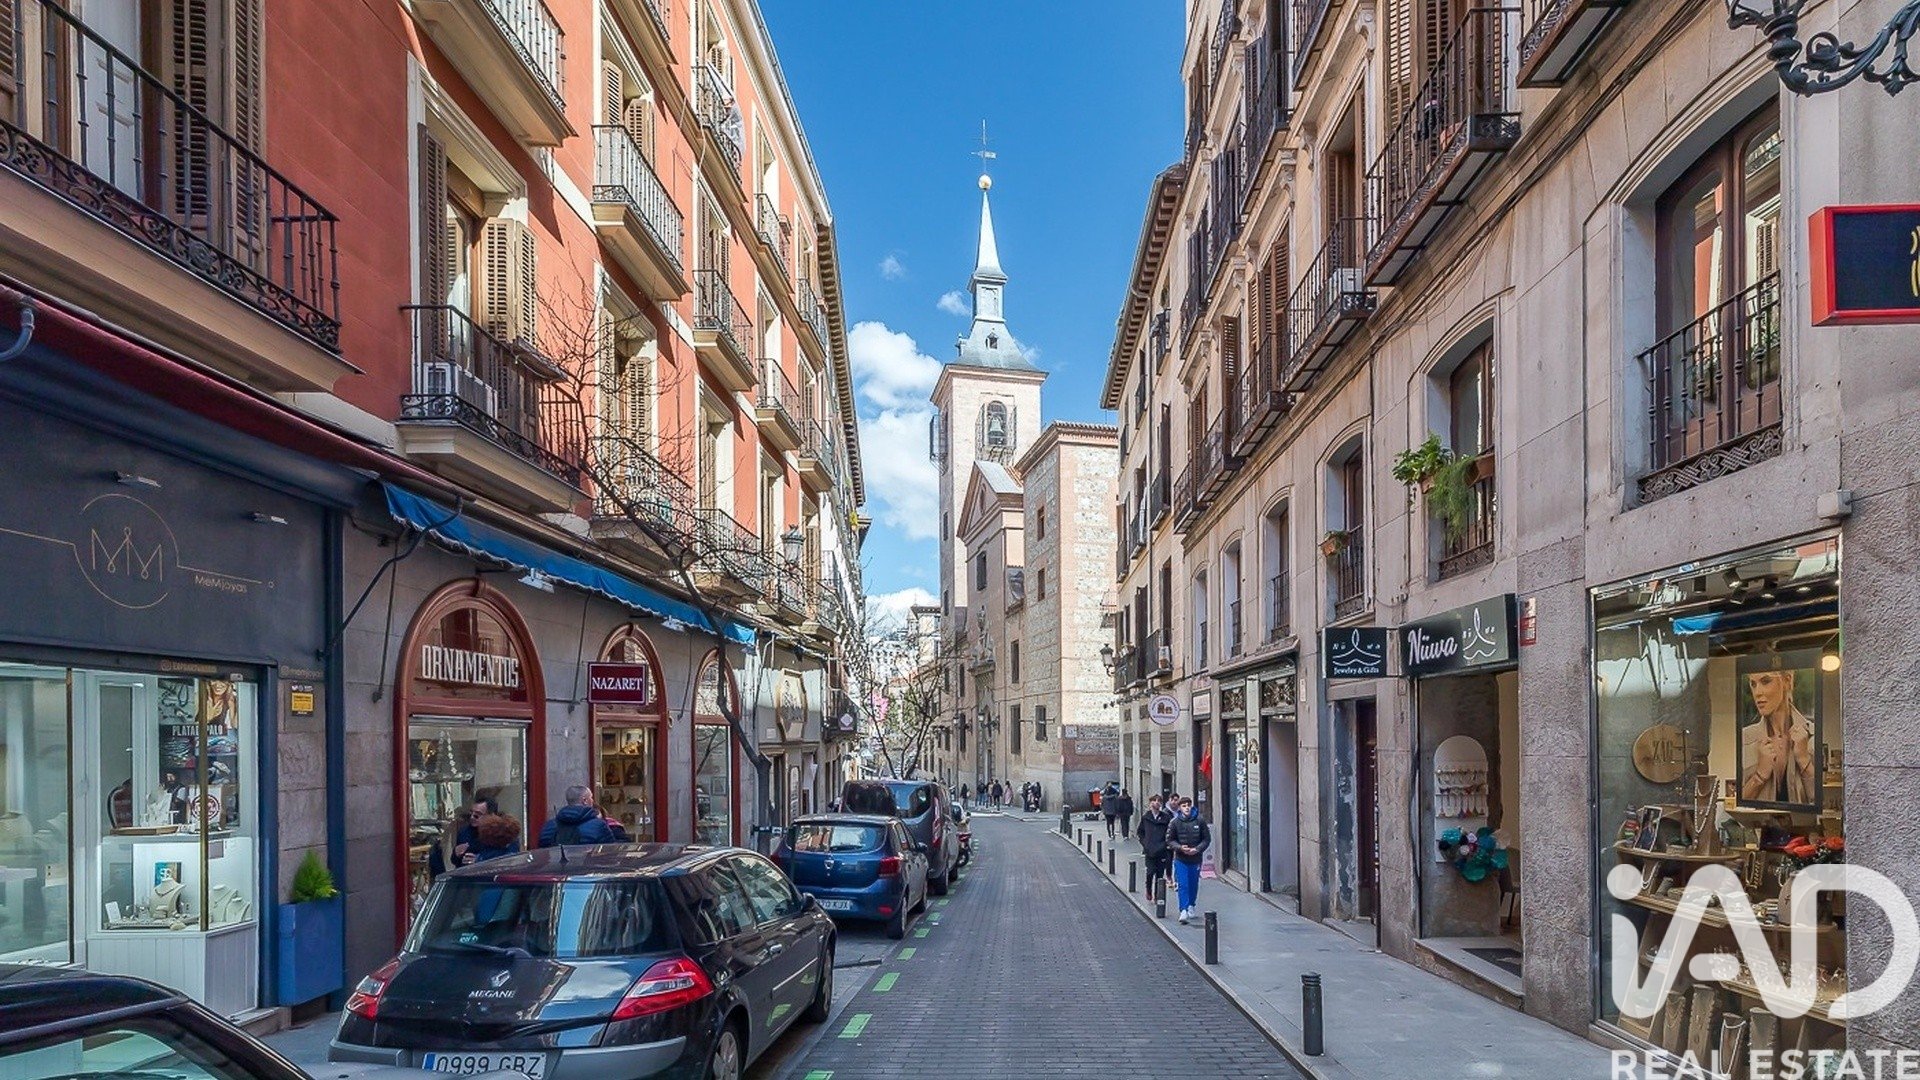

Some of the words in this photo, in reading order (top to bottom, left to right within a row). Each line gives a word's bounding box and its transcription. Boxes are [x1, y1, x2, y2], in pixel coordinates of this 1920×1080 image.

[1408, 628, 1459, 666] Nüwa
[422, 644, 519, 688] ORNAMENTOS
[592, 677, 643, 690] NAZARET
[437, 1056, 490, 1075] 0999
